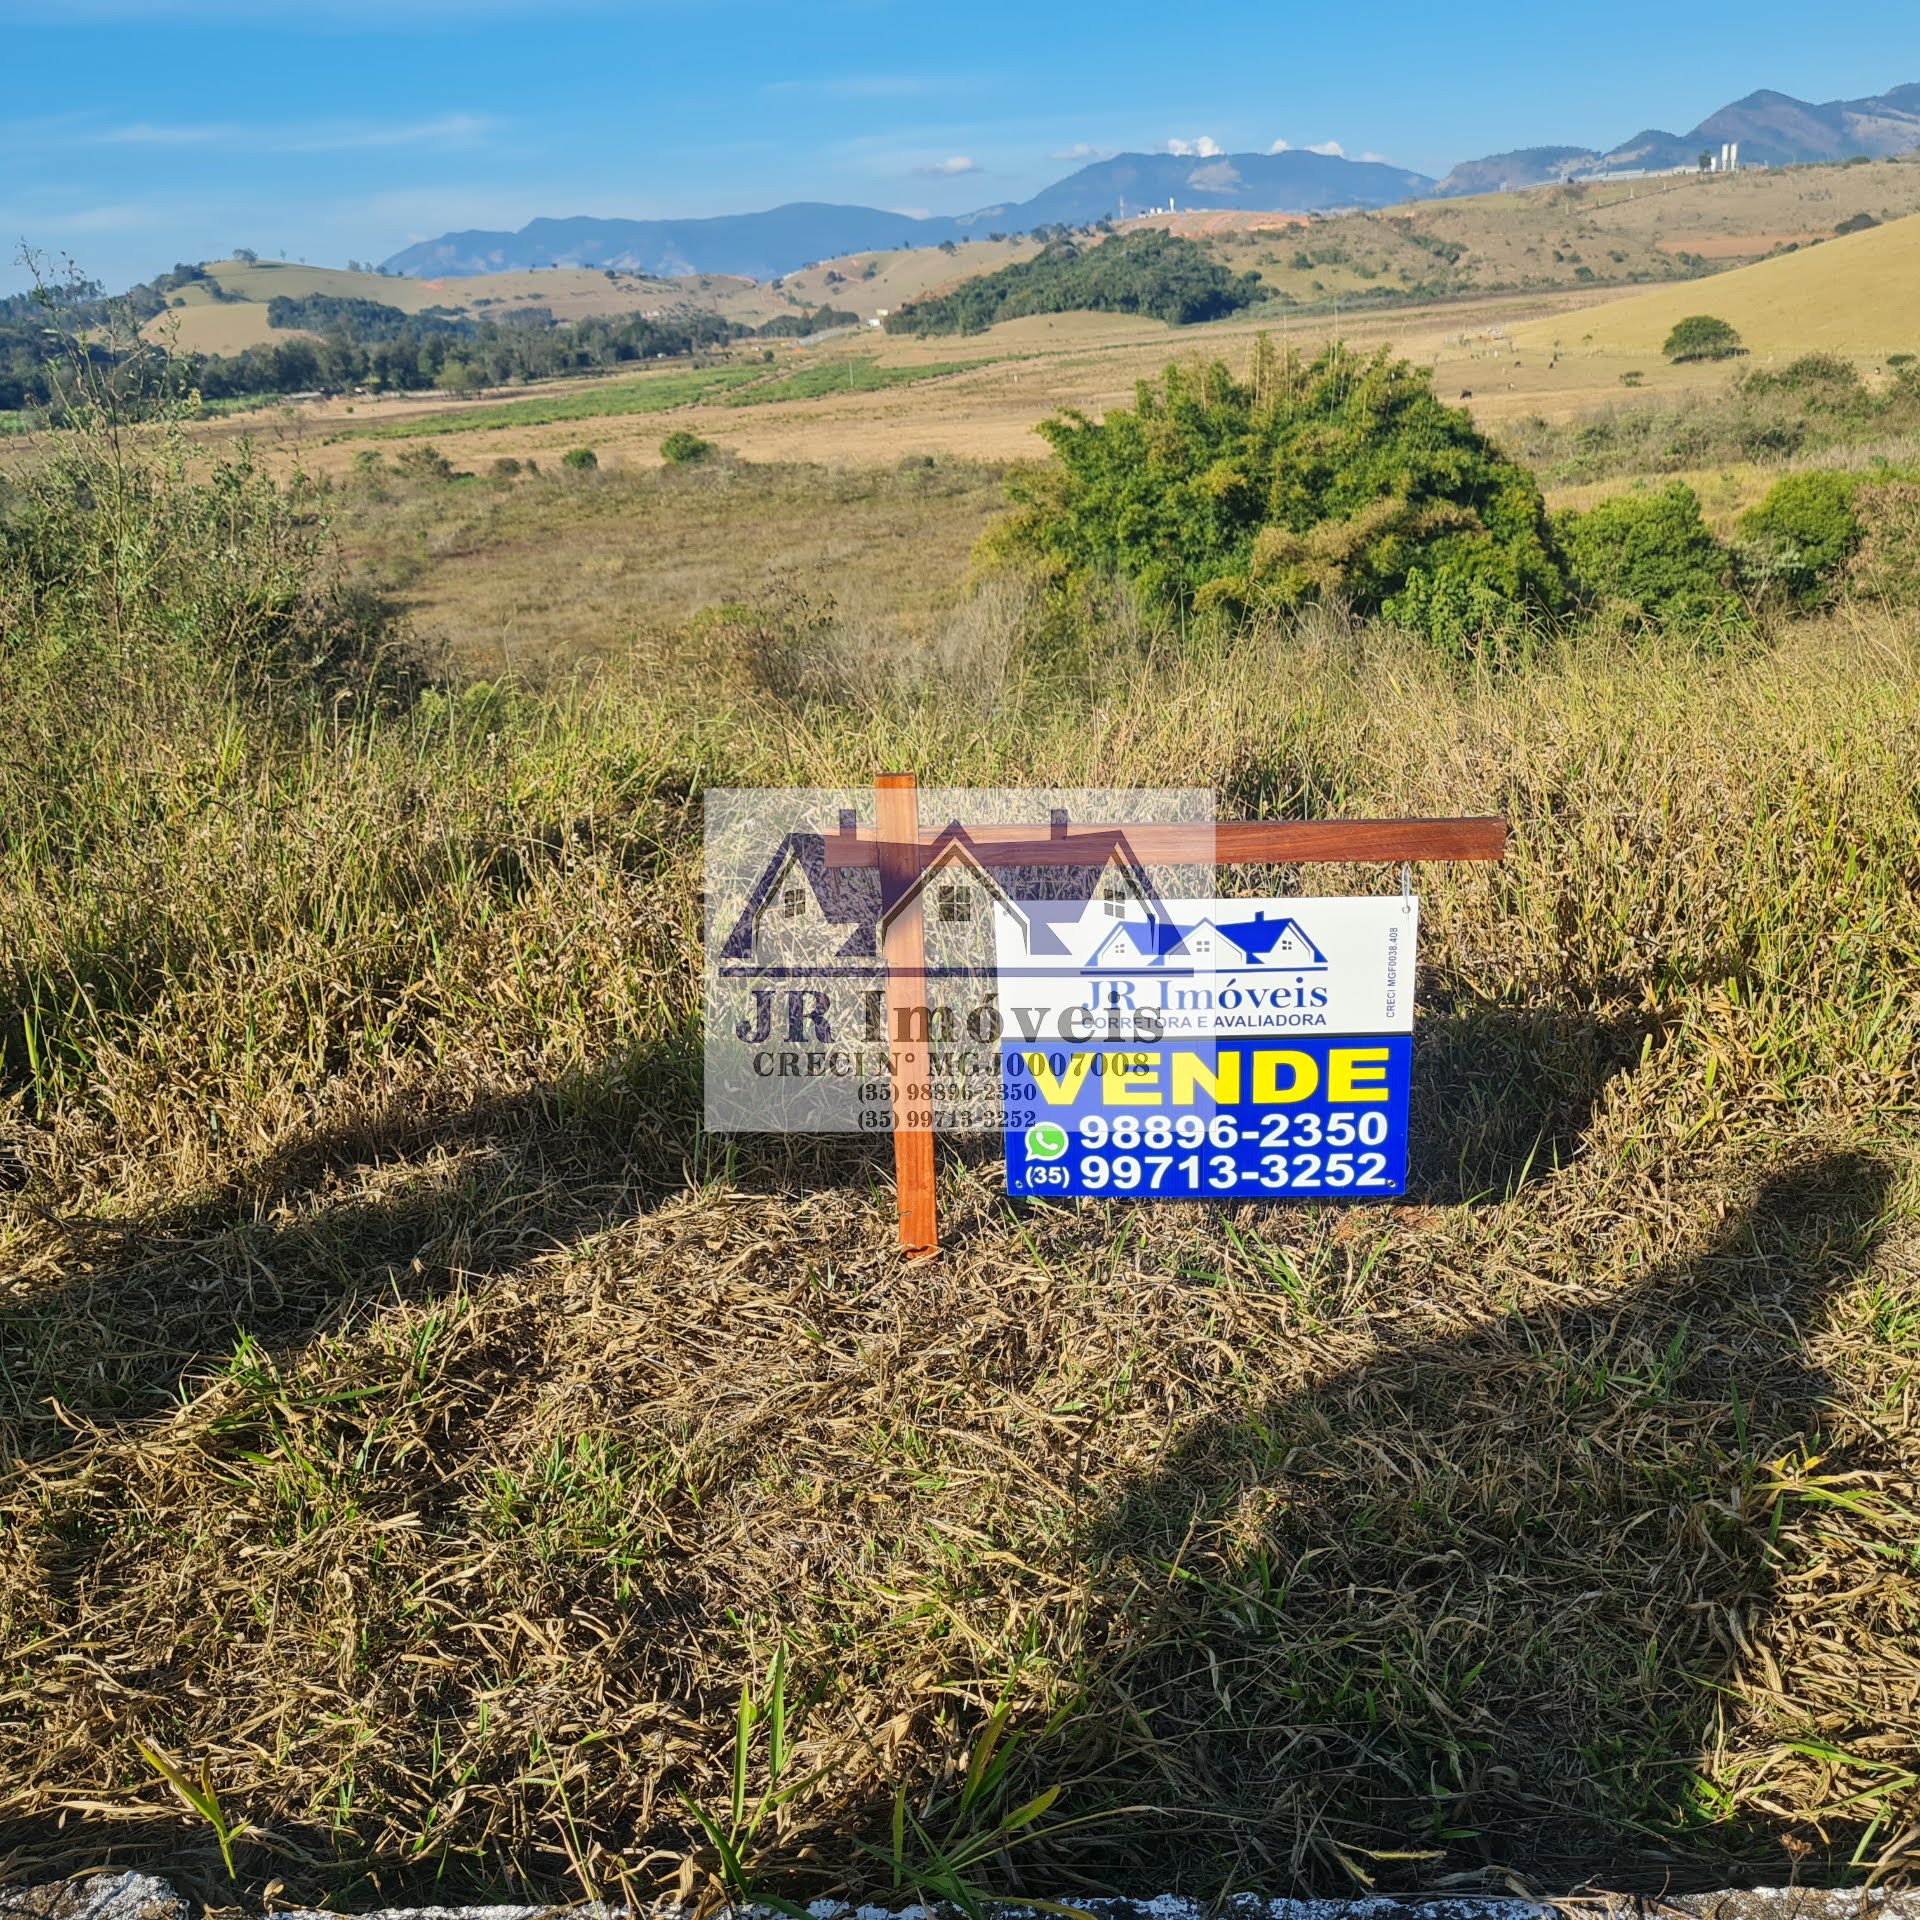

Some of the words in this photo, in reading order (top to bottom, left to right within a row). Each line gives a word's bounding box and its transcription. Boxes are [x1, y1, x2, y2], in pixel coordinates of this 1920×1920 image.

[1081, 980, 1136, 1012] JR
[1155, 976, 1329, 1010] Imóveis
[1386, 987, 1398, 1018] CRECI
[1081, 1016, 1193, 1029] CORRETORA
[1197, 1015, 1208, 1028] E
[1213, 1013, 1328, 1028] AVALIADORA
[1021, 1048, 1390, 1106] VENDE
[1079, 1111, 1389, 1150] 98896-2350
[1025, 1166, 1071, 1190] (35)
[1080, 1153, 1388, 1189] 99713-3252
